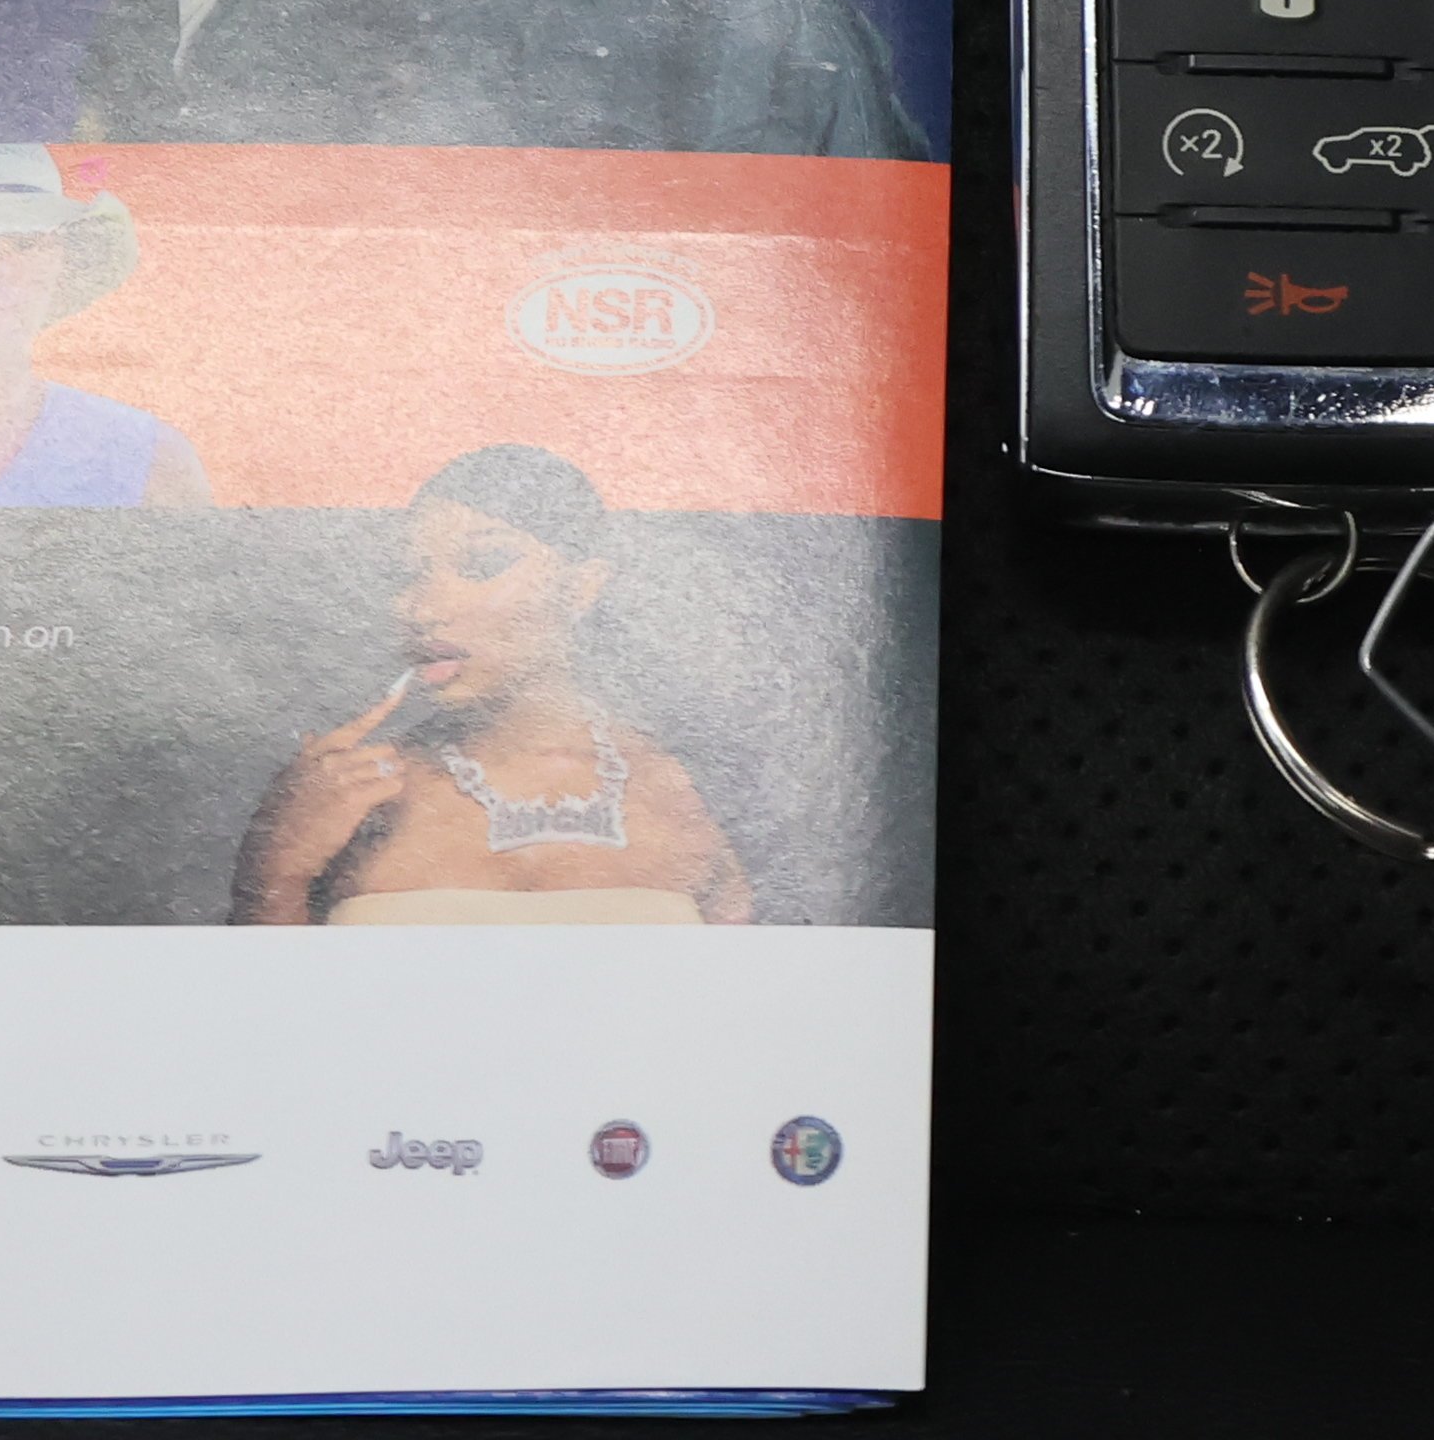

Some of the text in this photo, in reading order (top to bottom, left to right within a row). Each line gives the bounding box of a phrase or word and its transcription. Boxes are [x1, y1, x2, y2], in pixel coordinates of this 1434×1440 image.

[544, 288, 674, 334] NSR
[24, 625, 74, 650] on
[37, 1133, 231, 1147] CHRYSLER
[369, 1131, 485, 1176] Jeep
